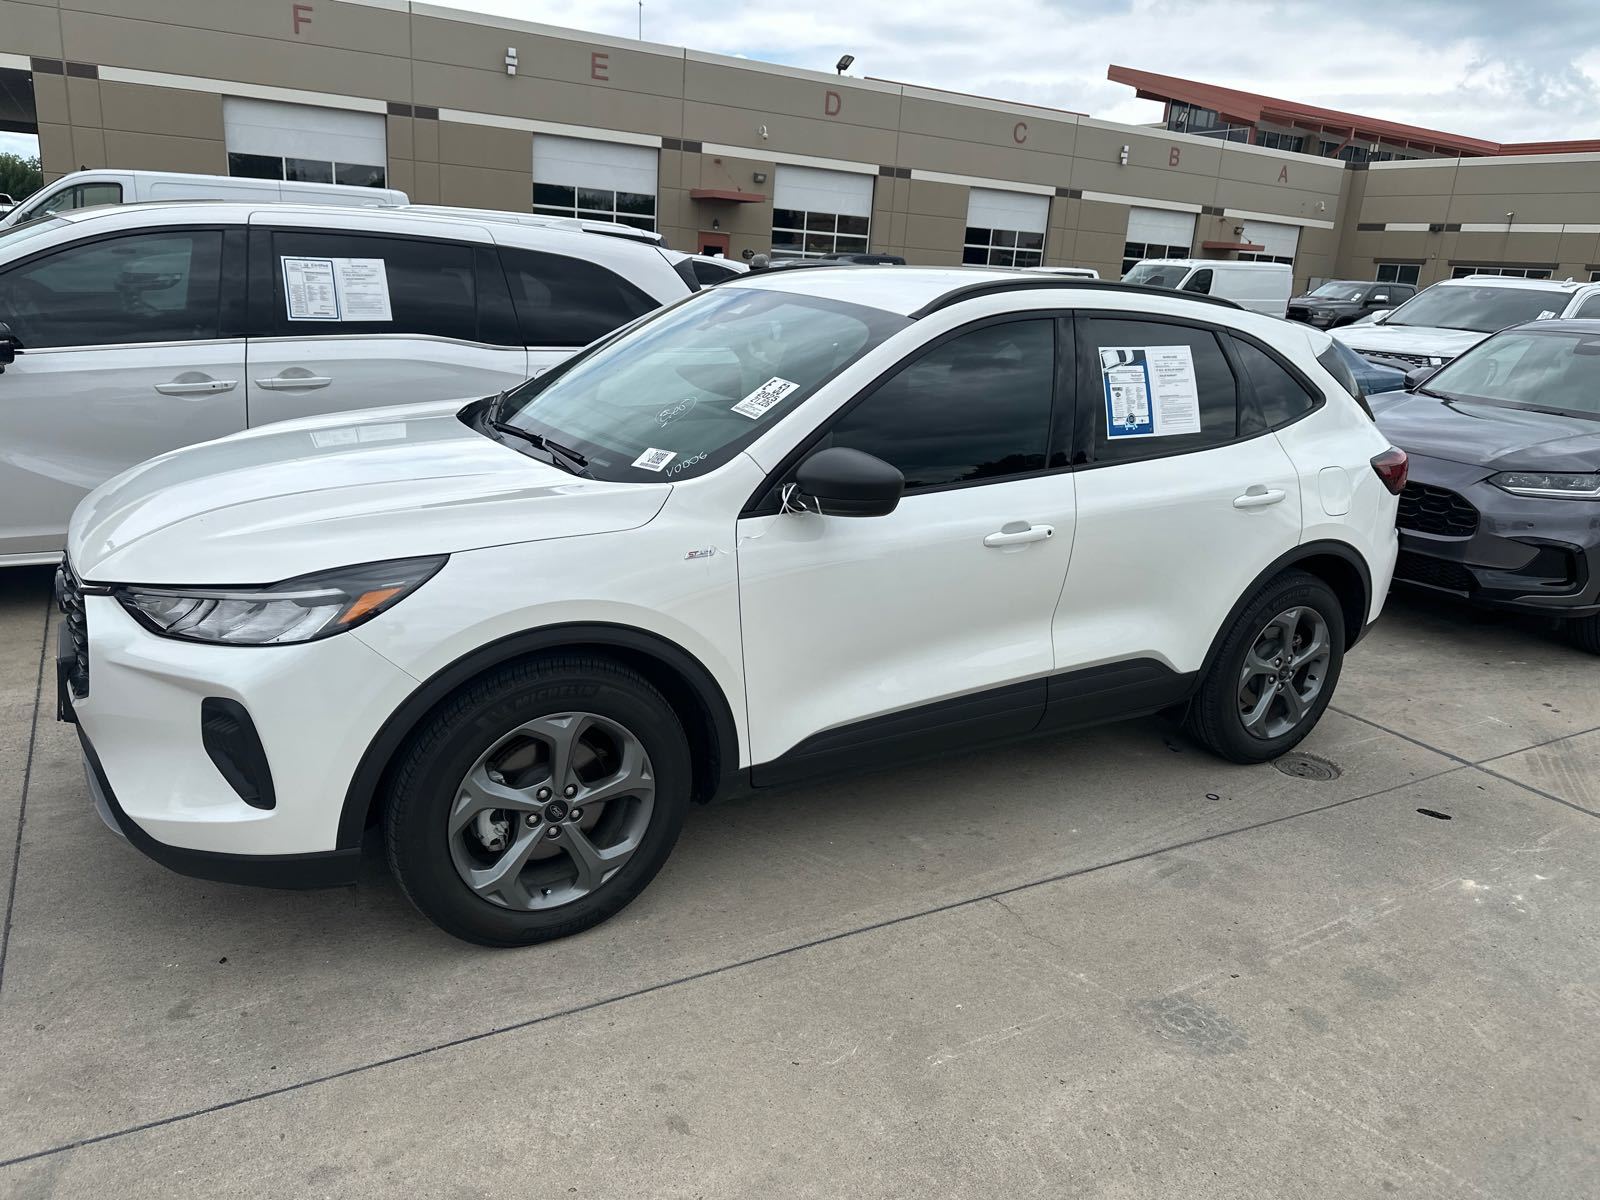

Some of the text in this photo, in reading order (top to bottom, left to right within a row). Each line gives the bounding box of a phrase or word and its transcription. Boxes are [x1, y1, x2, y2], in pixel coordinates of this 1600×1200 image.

[292, 4, 313, 34] F
[591, 52, 609, 81] E
[825, 91, 841, 116] D
[1014, 122, 1028, 144] C
[1168, 146, 1180, 167] B
[1277, 164, 1288, 184] A
[514, 684, 600, 709] MICHELIN
